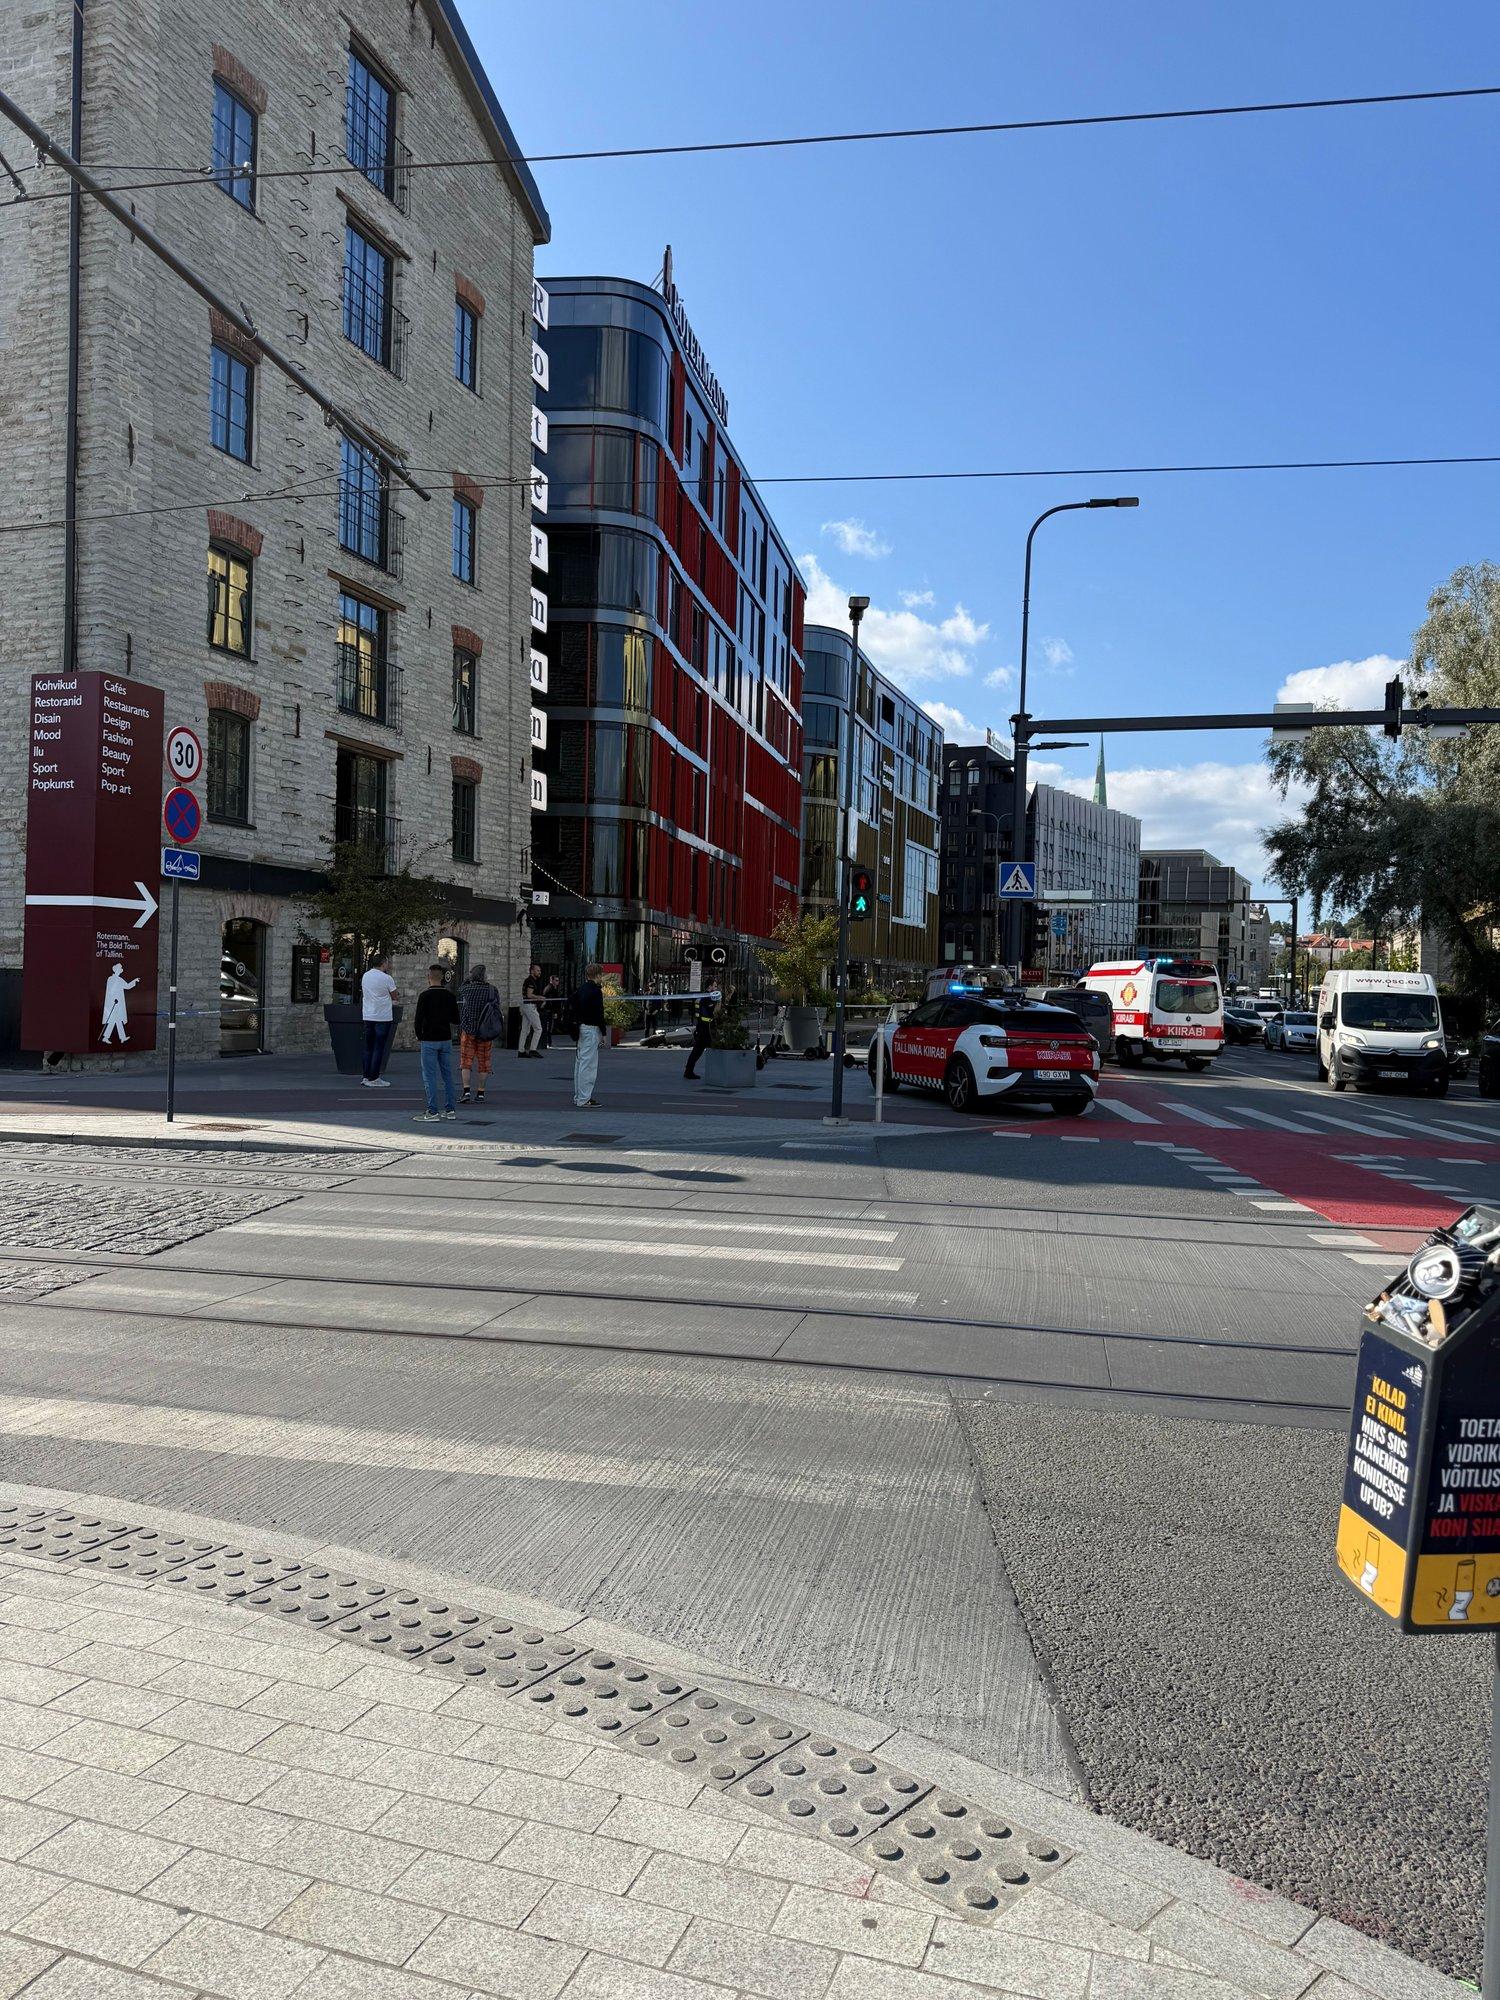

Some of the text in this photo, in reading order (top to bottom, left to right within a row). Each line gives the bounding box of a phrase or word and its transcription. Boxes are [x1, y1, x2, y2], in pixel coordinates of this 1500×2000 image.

[35, 679, 77, 691] Kohvikud
[103, 680, 127, 696] Cafés
[34, 695, 82, 708] Restoranid
[103, 696, 150, 718] Restaurants
[34, 713, 61, 724] Disain
[103, 713, 131, 730] Design
[33, 729, 61, 740] Mood
[102, 729, 134, 747] Fashion
[33, 746, 44, 757] Ilu
[102, 746, 131, 764] Beauty
[174, 740, 195, 769] 30
[32, 762, 58, 775] Sport
[101, 762, 125, 777] Sport
[32, 779, 75, 792] Popkunst
[101, 779, 132, 795] Pop art
[95, 949, 103, 957] of
[96, 940, 140, 950] The Bold Town
[1115, 1013, 1136, 1024] KIIRABI
[1167, 1026, 1206, 1037] KIIRABI
[893, 1041, 948, 1060] TALLINNA KIIRABI
[1036, 1050, 1072, 1061] KIIRABI
[1371, 1375, 1407, 1410] KALAD
[1365, 1394, 1407, 1436] EI KIMU.
[1460, 1418, 1500, 1438] TOETA
[1361, 1414, 1408, 1460] MIKS SIIS
[1355, 1433, 1409, 1484] LÄÄNEMERI
[1448, 1443, 1500, 1463] VIDRIK
[1353, 1455, 1407, 1507] KONIDESSE
[1441, 1463, 1500, 1488] VÕITLUS
[1359, 1482, 1394, 1520] UPUB?
[1437, 1493, 1455, 1513] JA
[1430, 1518, 1500, 1537] KONI SIIA
